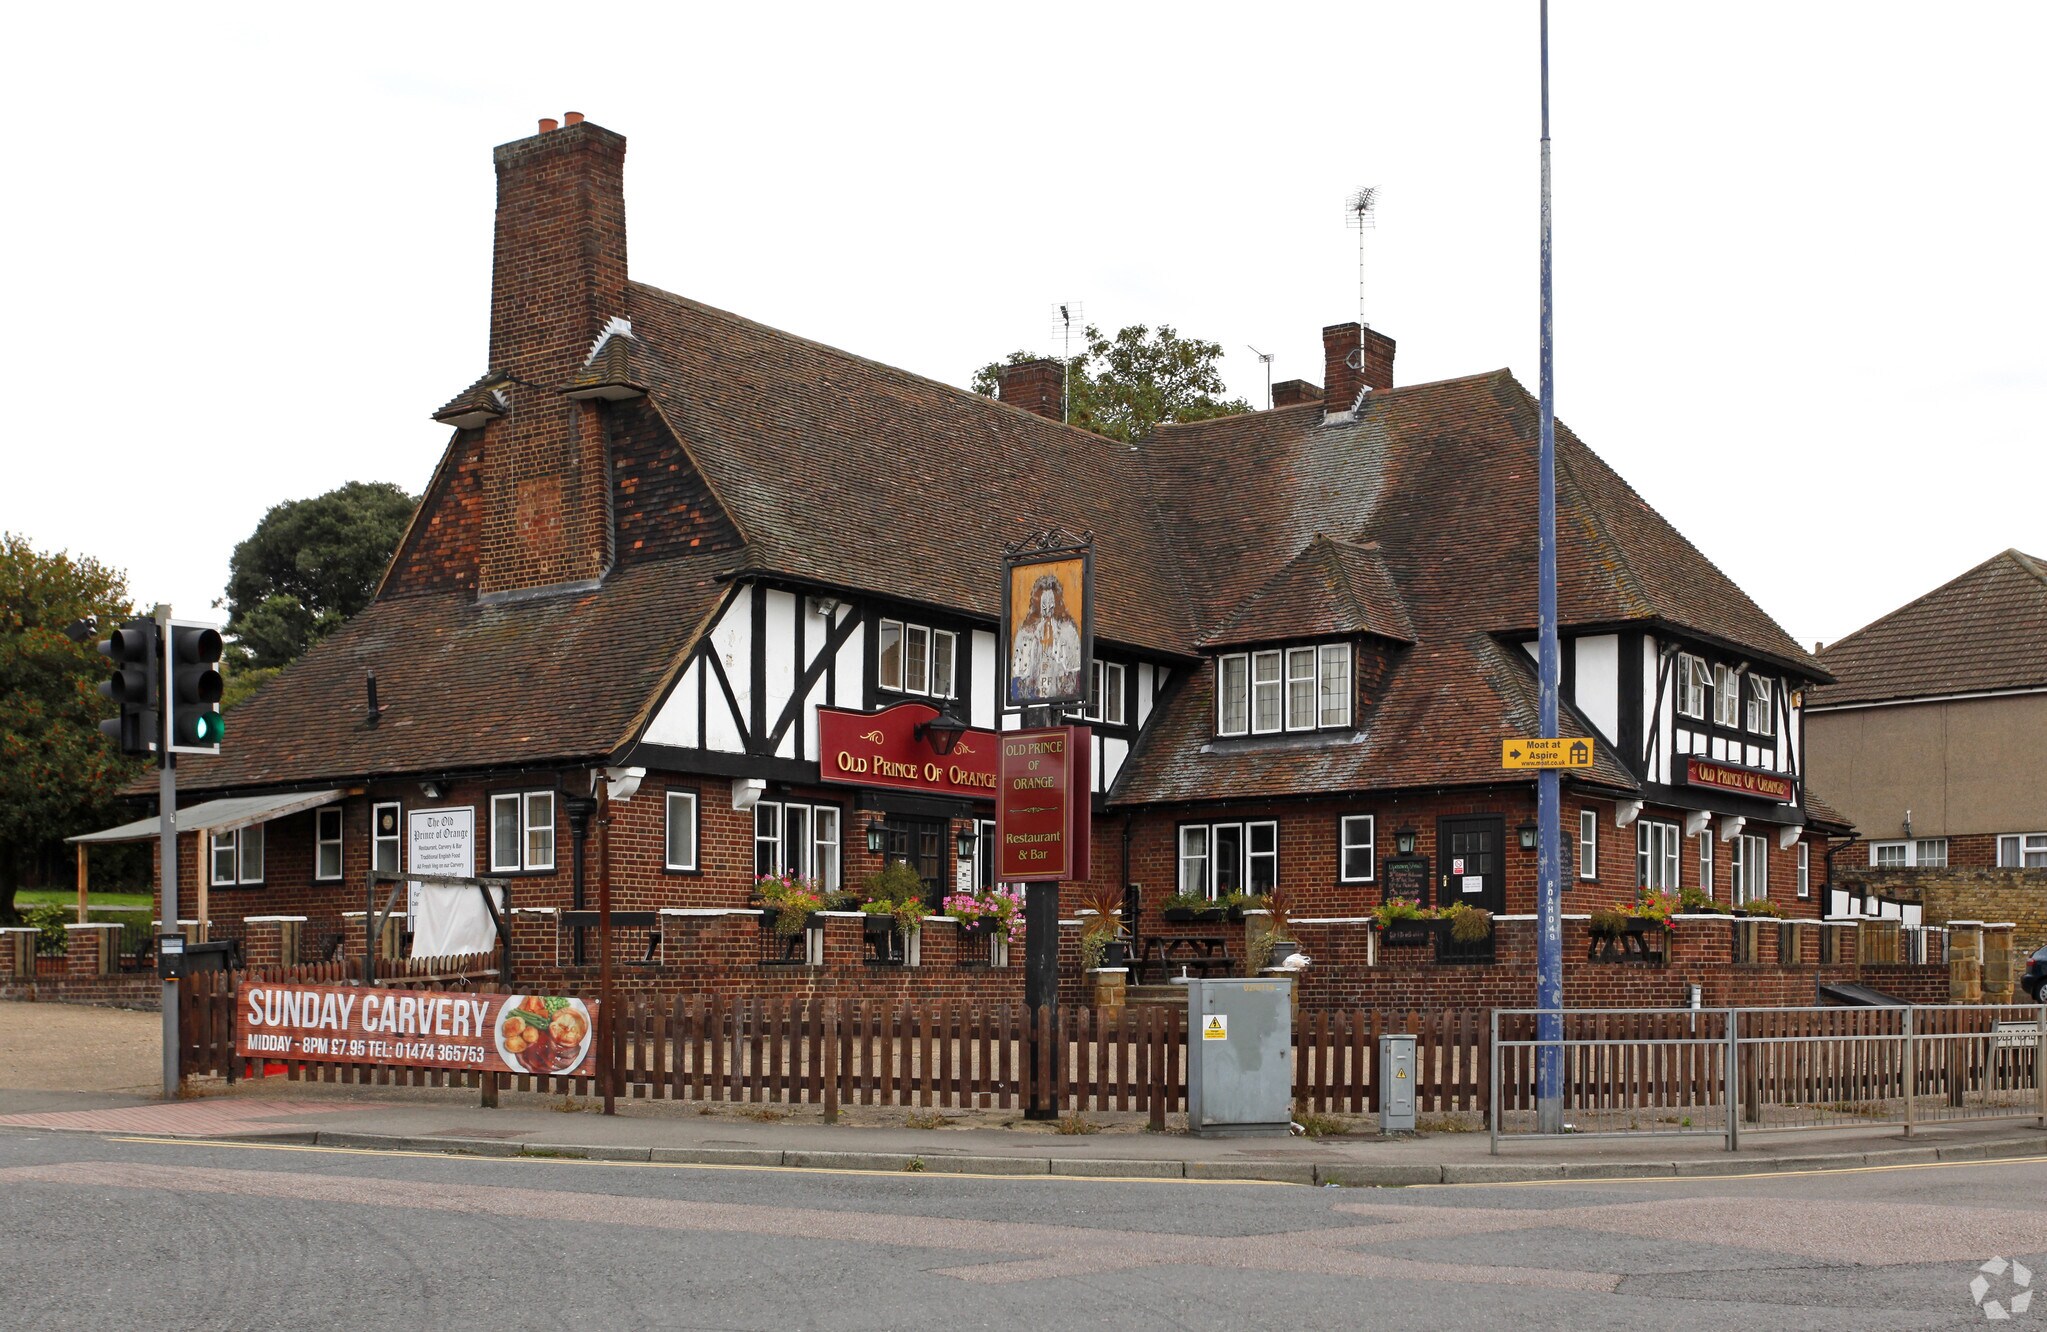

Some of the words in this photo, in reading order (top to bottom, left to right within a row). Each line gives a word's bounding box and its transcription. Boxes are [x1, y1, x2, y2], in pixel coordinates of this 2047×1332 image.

[1005, 744, 1026, 756] OLD
[1028, 741, 1063, 754] PRINCE
[1526, 741, 1549, 749] Moat
[1551, 741, 1561, 749] at
[1529, 751, 1558, 760] Aspire
[837, 751, 867, 773] OLD
[872, 755, 918, 779] PRINCE
[1028, 760, 1040, 771] OF
[1013, 776, 1054, 790] ORANGE
[1699, 763, 1714, 780] OLD
[1718, 768, 1742, 786] PRINCE
[1758, 775, 1784, 794] ORANGE
[427, 817, 439, 828] The
[441, 816, 454, 827] Old
[414, 830, 434, 842] Prince
[436, 829, 442, 839] of
[443, 828, 469, 840] Orange
[1006, 831, 1061, 844] Restaurant
[1018, 849, 1028, 860] &
[1030, 849, 1048, 860] Bar
[247, 988, 356, 1030] SUNDAY
[361, 995, 489, 1037] CARVERY
[247, 1033, 292, 1053] MIDDAY
[302, 1036, 329, 1054] 8PM
[331, 1038, 366, 1056] £7.95
[368, 1041, 394, 1059] TEL:
[395, 1042, 435, 1060] 01474
[437, 1044, 485, 1063] 365753
